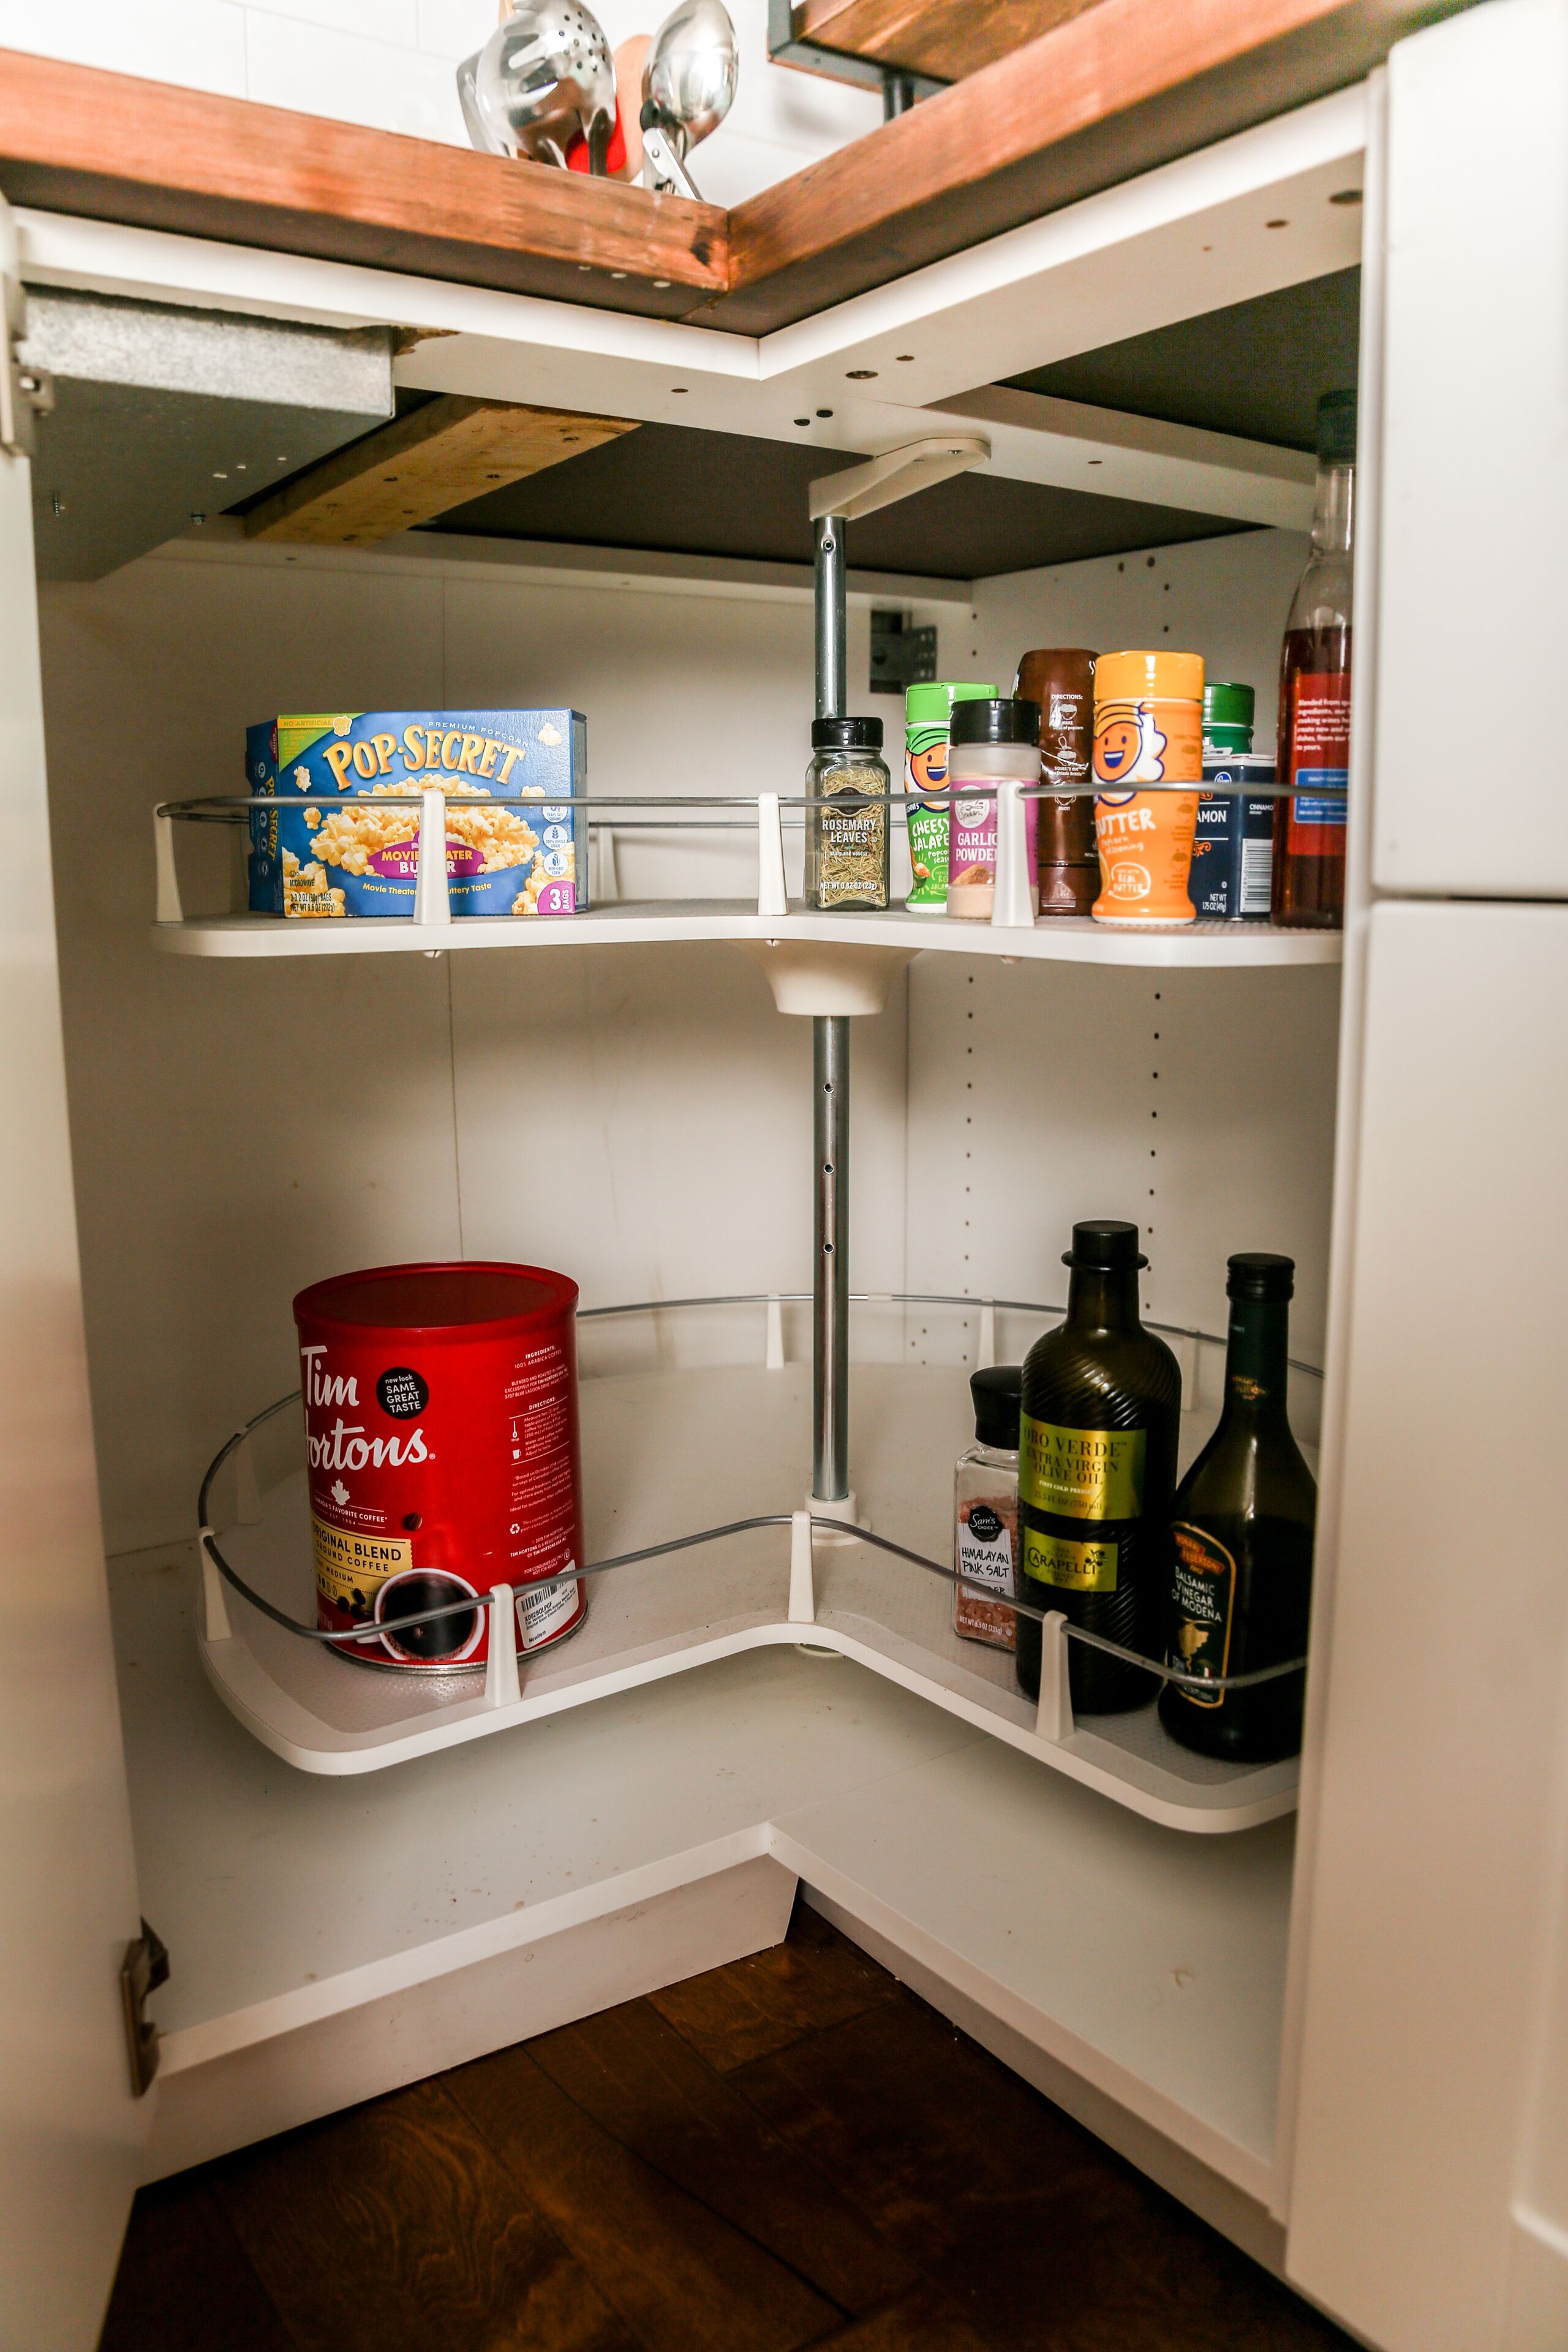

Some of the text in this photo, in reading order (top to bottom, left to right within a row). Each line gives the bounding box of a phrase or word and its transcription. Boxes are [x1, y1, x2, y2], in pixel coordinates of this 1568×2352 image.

[428, 722, 529, 748] PREMIUM POPCORN
[1096, 808, 1156, 837] UTTER
[1196, 810, 1227, 823] AMON
[822, 819, 876, 831] ROSEMARY
[830, 831, 867, 843] LEAVES
[913, 833, 949, 852] JALAPE
[927, 849, 949, 859] popco
[363, 883, 386, 893] Movie
[471, 883, 491, 892] Taste
[862, 882, 878, 891] (23g)
[320, 893, 332, 902] BAGS
[549, 888, 561, 911] 3
[1219, 894, 1227, 902] WT
[322, 903, 335, 913] (272g)
[1210, 902, 1216, 910] OZ
[525, 1345, 556, 1359] INGREDIENTS:
[527, 1349, 562, 1366] ARABICA COFFEE
[301, 1345, 360, 1406] Tim
[399, 1374, 413, 1382] look
[511, 1378, 529, 1386] BLENDED
[386, 1382, 417, 1394] SAME
[505, 1384, 529, 1393] EXCLUSIVELY
[525, 1386, 540, 1395] LAGOON
[386, 1390, 420, 1404] GREAT
[529, 1396, 556, 1411] DIRECTIONS:
[390, 1400, 421, 1414] TASTE
[524, 1414, 541, 1422] Measure
[1023, 1427, 1049, 1449] ORO
[1027, 1446, 1120, 1473] EXTRA VIRGIN
[1035, 1461, 1103, 1485] OLIVE OIL
[1039, 1480, 1053, 1489] FIRST
[333, 1506, 358, 1518] FAVORITE
[970, 1513, 996, 1528] Sam's
[313, 1521, 402, 1561] ORIGINAL BLEND
[540, 1542, 556, 1553] HORTONS
[317, 1539, 389, 1572] GROUND COFFEE
[519, 1545, 538, 1555] HORTONS
[962, 1547, 1009, 1564] HIMALAYAN
[532, 1561, 551, 1572] CONSUMER
[1028, 1547, 1096, 1575] CARAPELLI
[326, 1566, 353, 1583] MEDIUM
[962, 1560, 1010, 1578] PINK SALT
[1175, 1565, 1216, 1596] BALSAMIC
[1175, 1578, 1214, 1608] VINEGAR
[1171, 1588, 1223, 1623] OF MODENA
[982, 1621, 988, 1630] OZ
[988, 1623, 1002, 1635] (235g)
